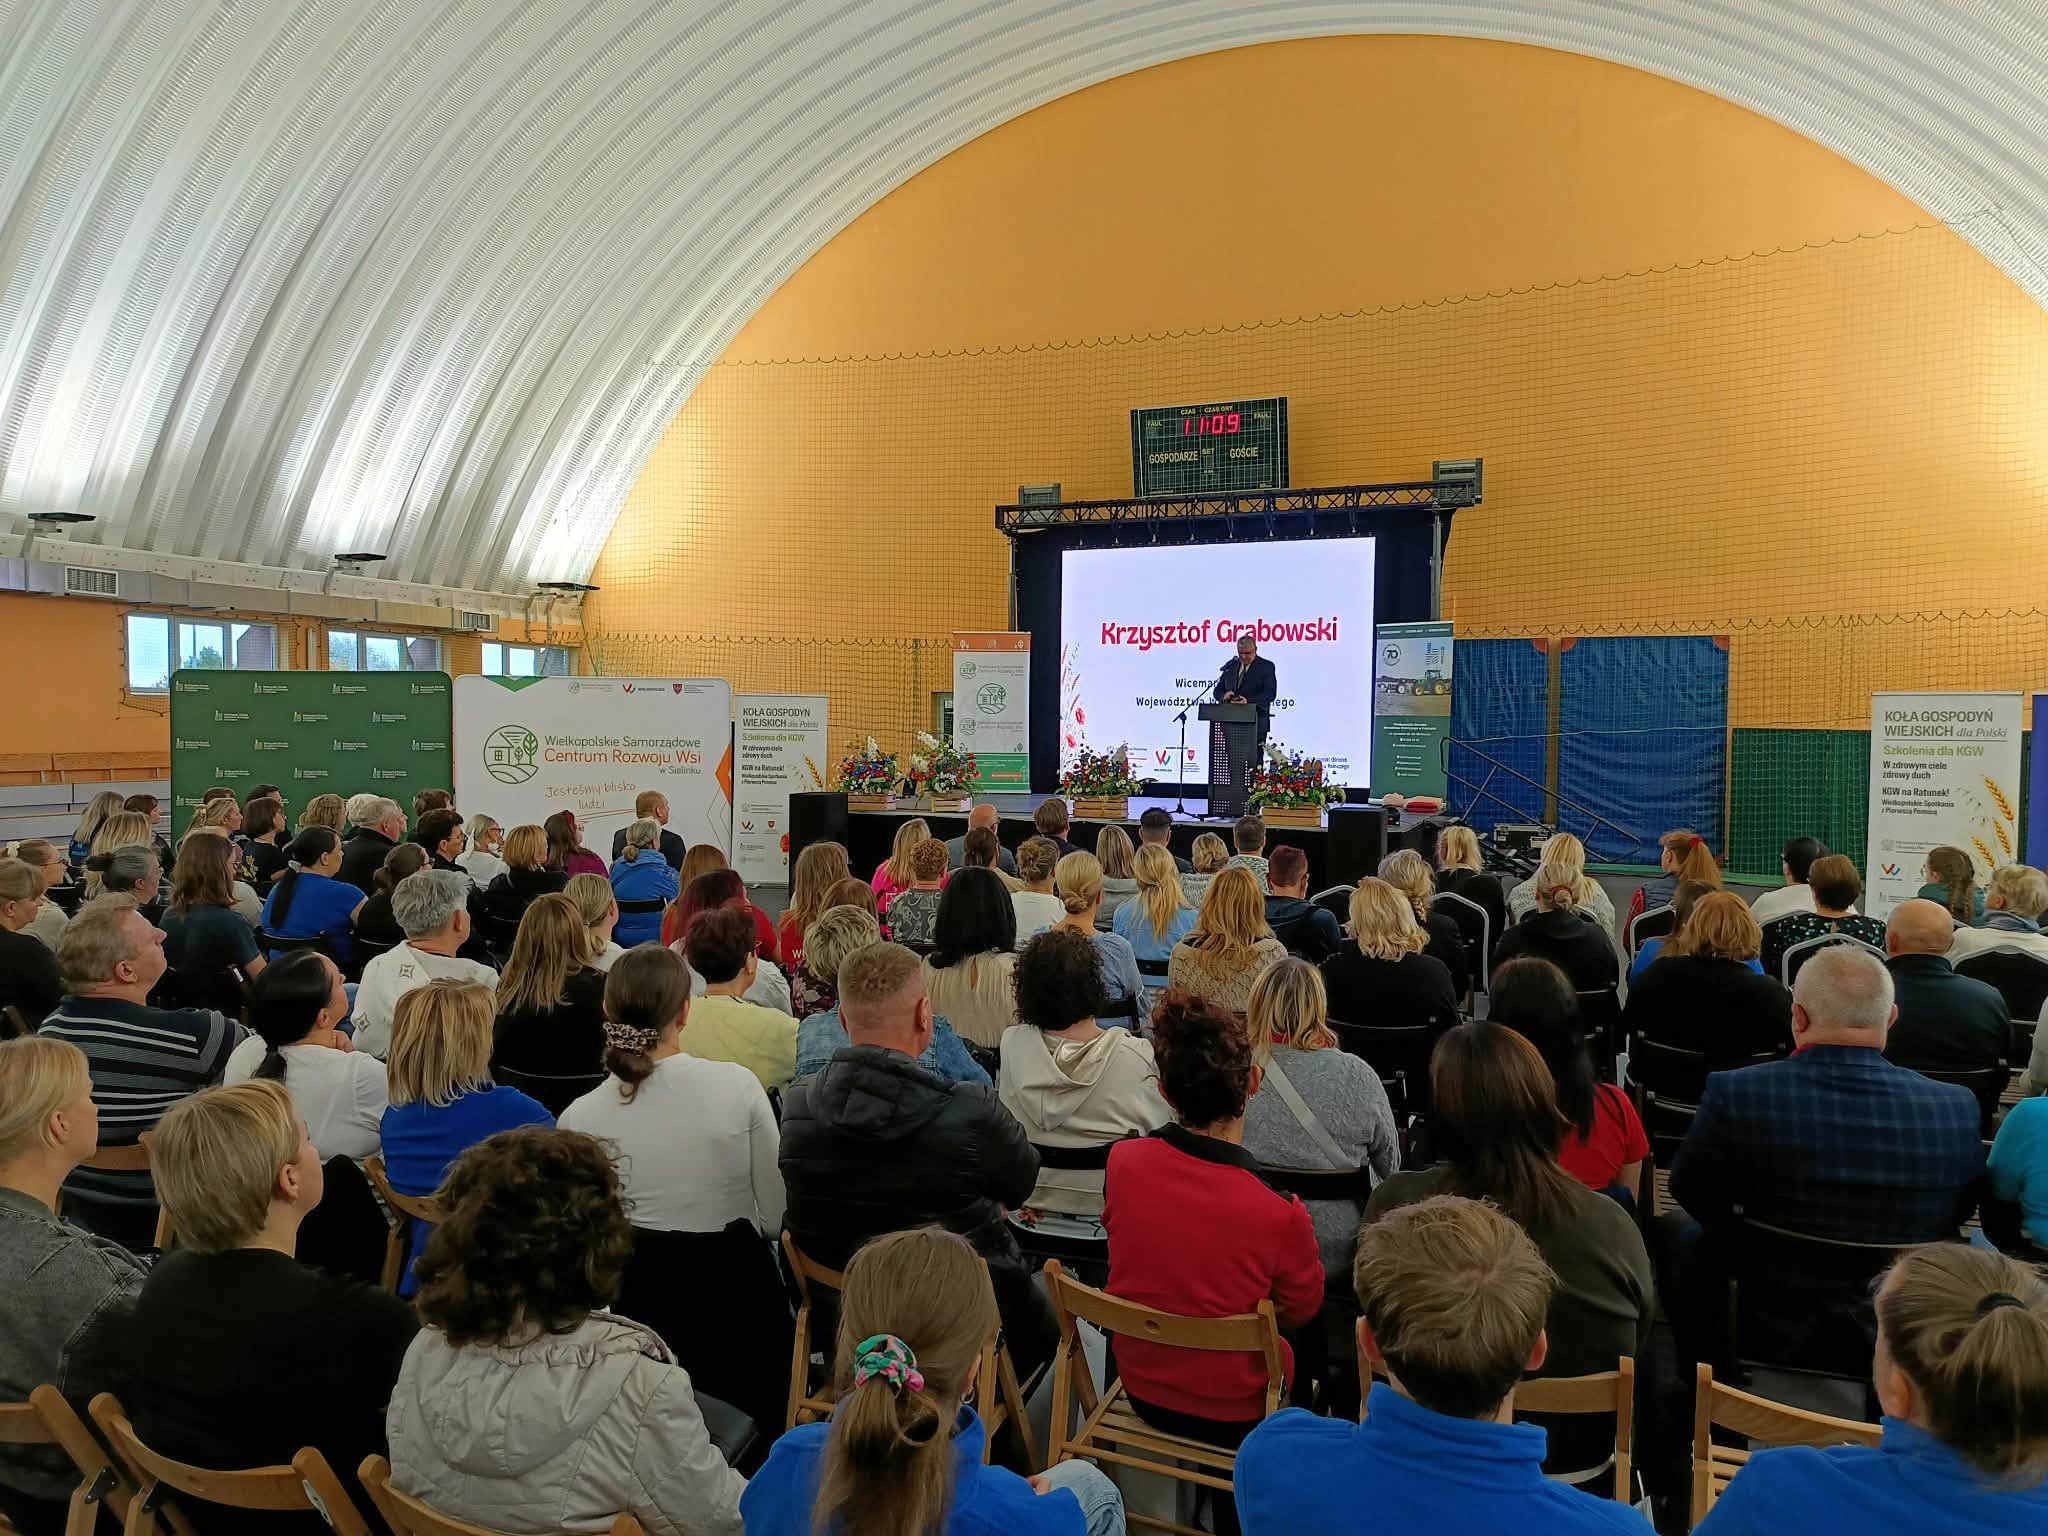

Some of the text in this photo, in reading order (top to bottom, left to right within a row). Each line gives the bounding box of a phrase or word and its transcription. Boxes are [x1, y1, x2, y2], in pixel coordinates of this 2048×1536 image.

[1149, 450, 1199, 464] GOSPODARZE
[1230, 445, 1259, 458] GOŚCIE
[1101, 616, 1339, 650] Krzysztof Grabowski
[1175, 678, 1218, 688] Wicemar
[743, 707, 765, 717] KOŁA
[1884, 708, 1993, 722] KOŁA GOSPODYŃ
[743, 719, 787, 728] WIEJSKICH
[1884, 725, 2008, 738] WIEJSKICH dla Polski
[545, 735, 701, 749] Wielkopolskie Samorządowe
[1883, 745, 1985, 756] Szkolenia dla KGW
[544, 748, 701, 767] Centrum Rozwoju Wsi
[668, 766, 701, 775] Sielinku
[1882, 761, 1891, 769] W
[1892, 761, 1927, 770] zdrowym
[1882, 771, 1931, 780] zdrowy duch
[544, 779, 636, 798] Jesteśmy blisko
[1882, 787, 1901, 796] KGW
[1913, 788, 1950, 797] Ratunek!
[578, 799, 605, 810] ludzi
